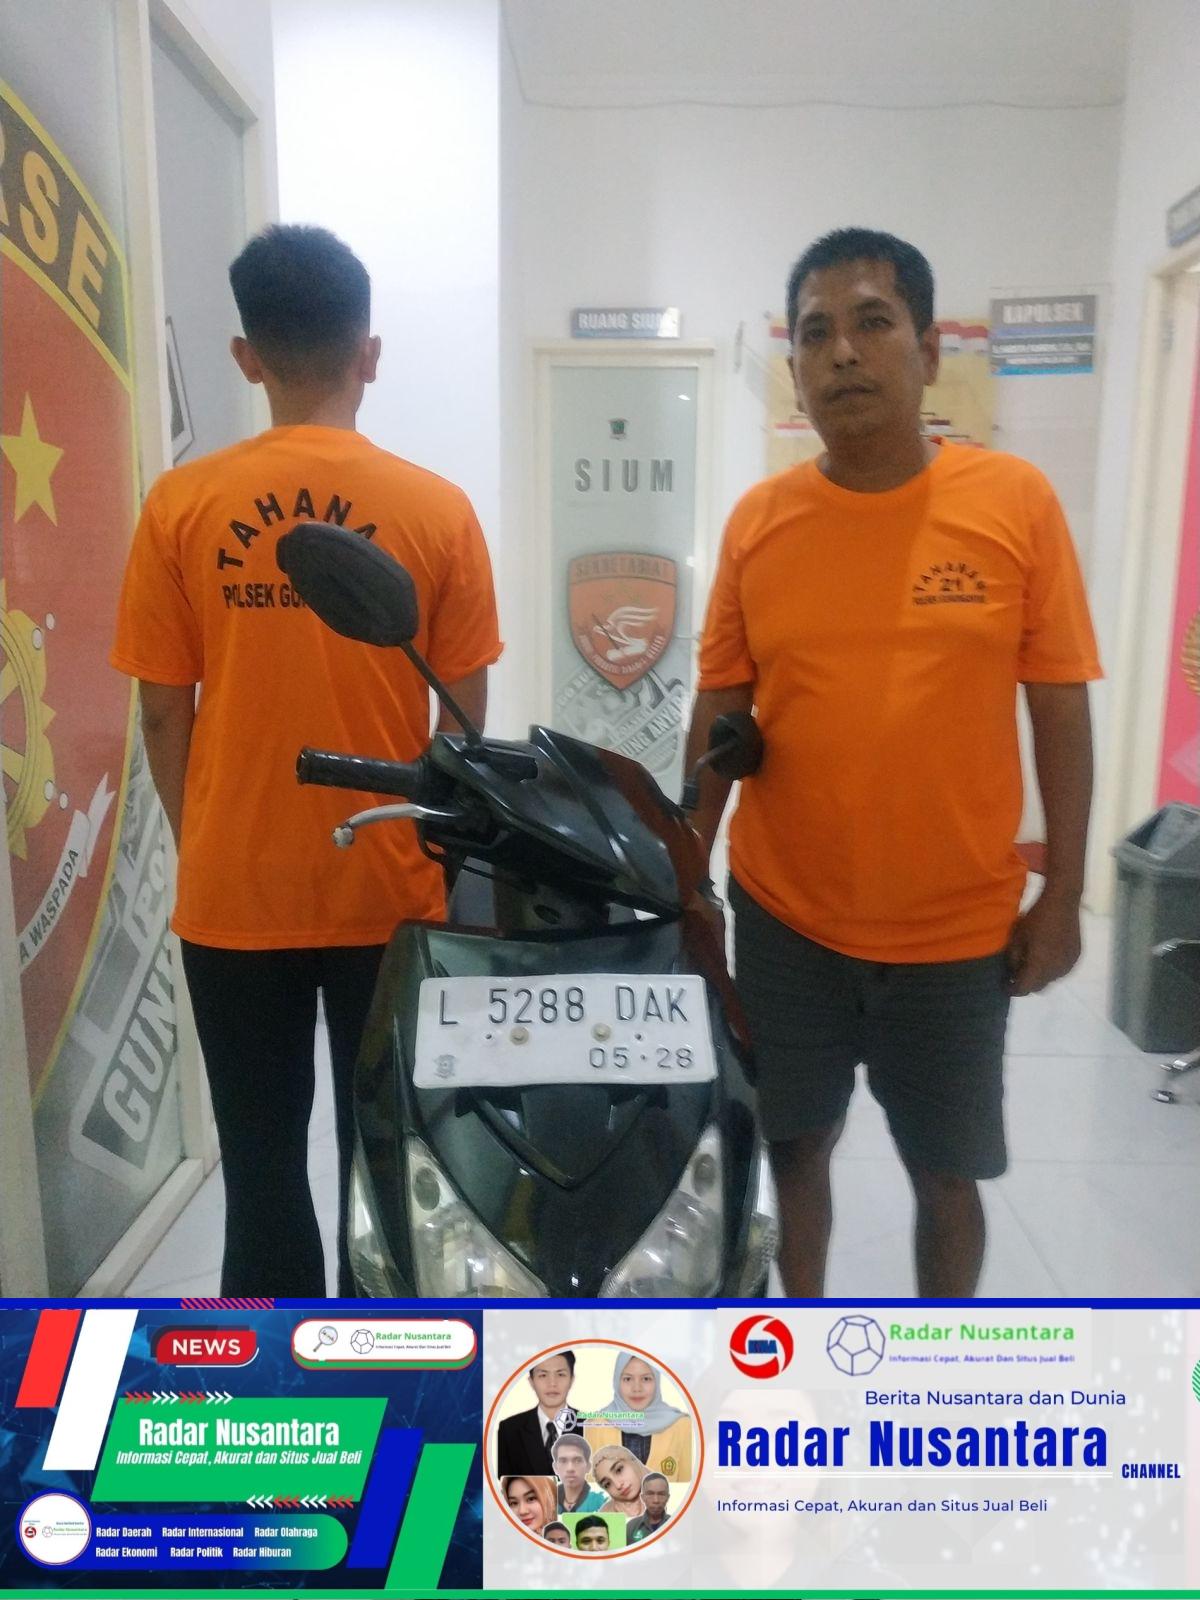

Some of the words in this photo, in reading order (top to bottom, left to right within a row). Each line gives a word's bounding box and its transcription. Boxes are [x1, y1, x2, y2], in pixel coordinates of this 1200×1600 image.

[578, 312, 628, 329] RUANG
[631, 311, 668, 330] SIU
[574, 458, 673, 493] SIUM
[217, 488, 377, 571] TAHANA
[279, 582, 310, 609] GU
[28, 848, 79, 947] WASPADA
[439, 989, 458, 1025] L
[487, 986, 585, 1024] 5288
[615, 984, 688, 1023] DAK
